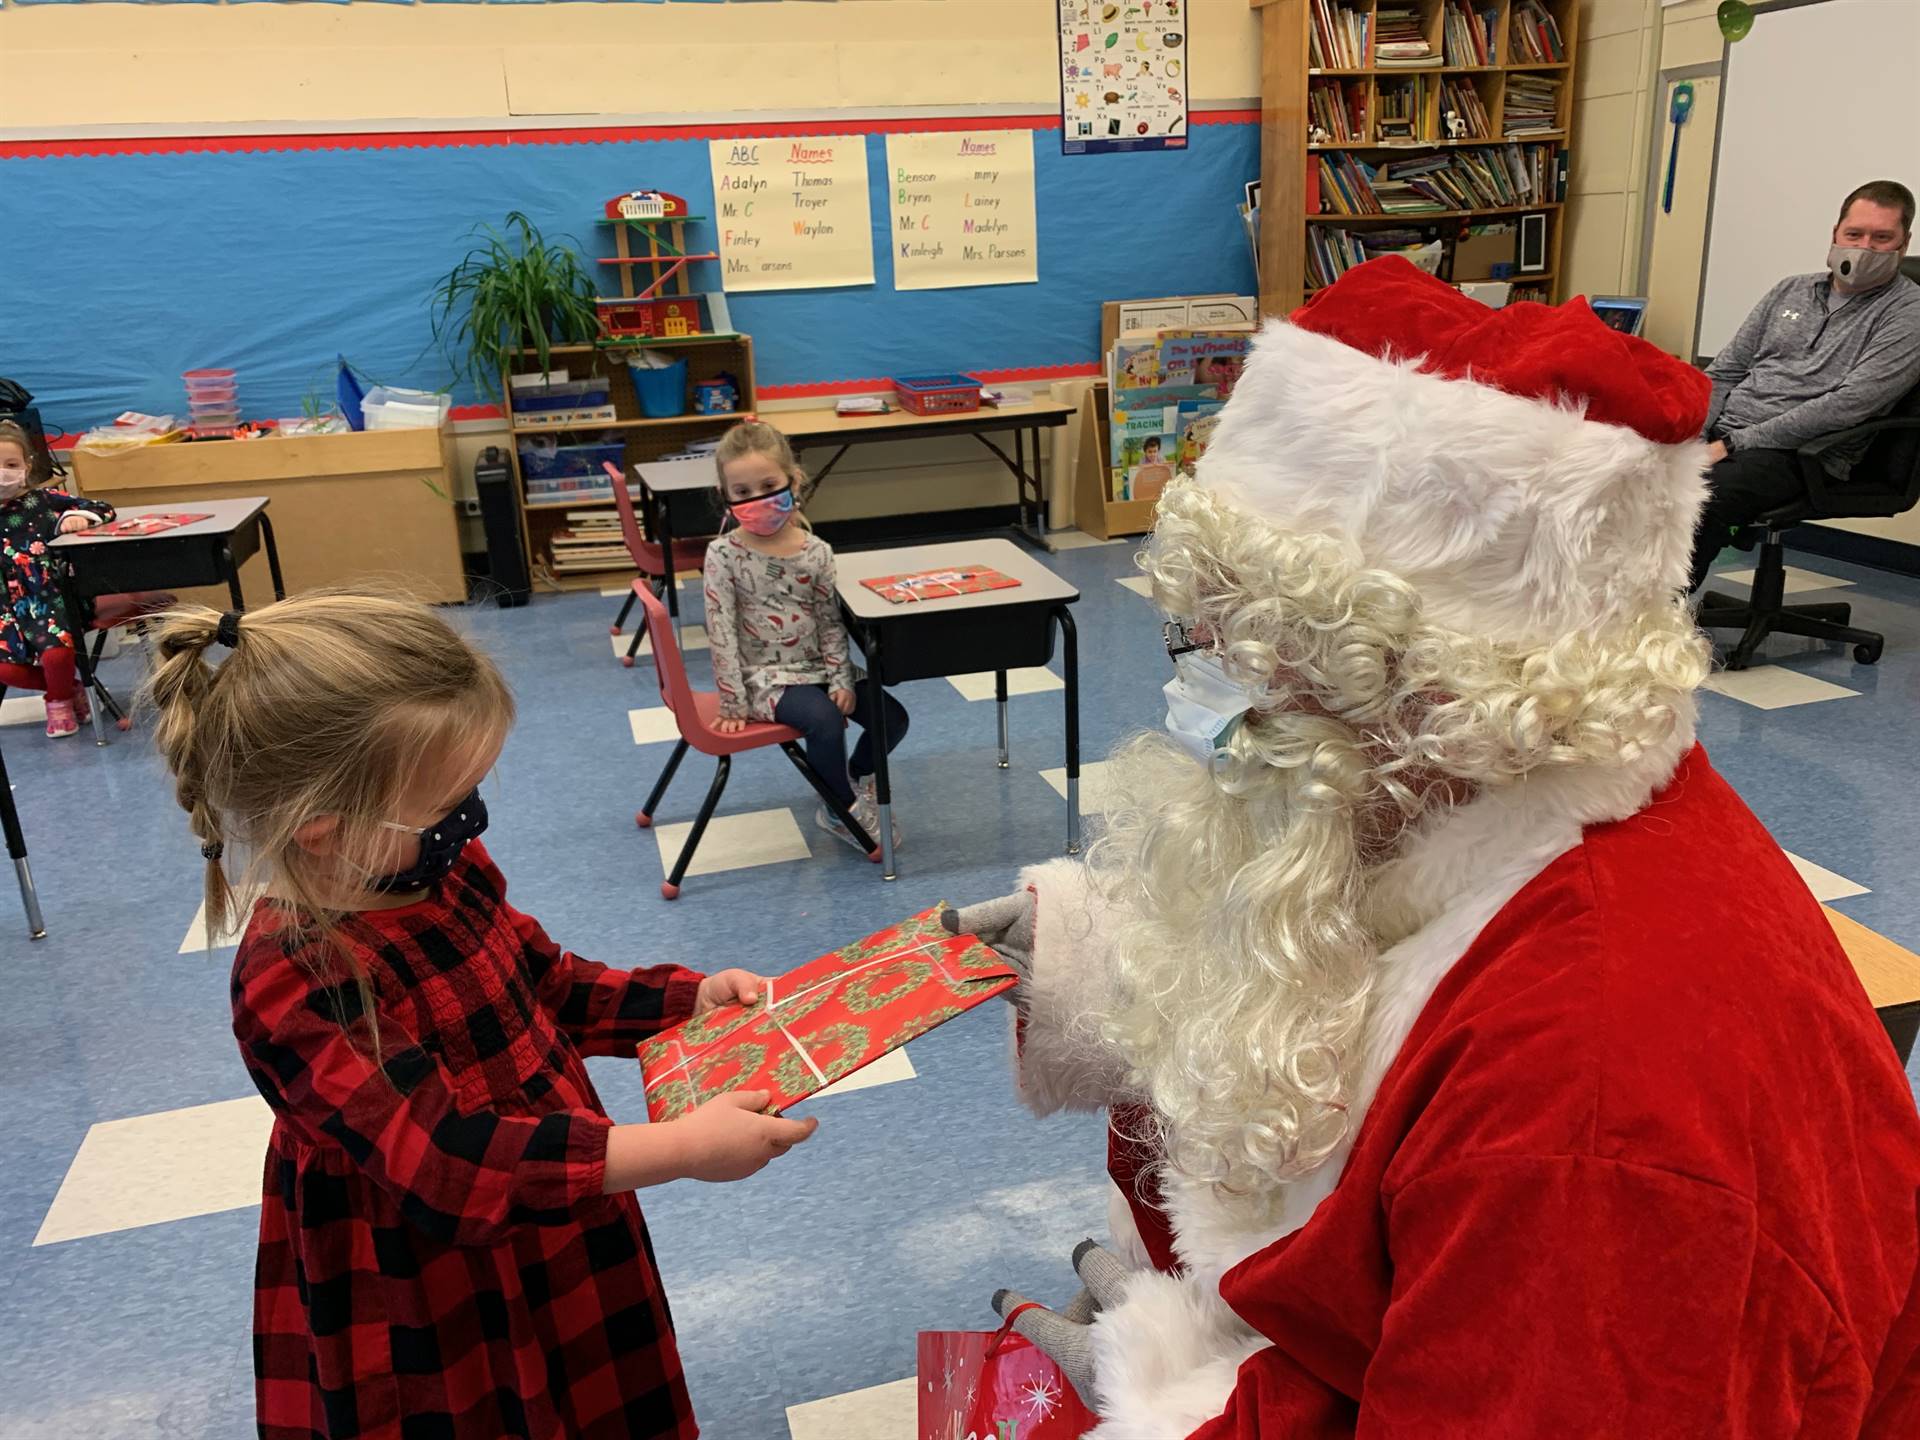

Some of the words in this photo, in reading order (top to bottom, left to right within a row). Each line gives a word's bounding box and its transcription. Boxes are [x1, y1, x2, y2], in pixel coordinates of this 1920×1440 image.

[731, 145, 760, 162] ABC
[790, 143, 833, 160] Names
[961, 137, 996, 153] Names
[792, 171, 833, 187] Thomas
[897, 167, 937, 183] Benson
[720, 174, 767, 194] Adalyn
[791, 192, 829, 210] Troyer
[898, 187, 932, 207] Brynn
[744, 201, 754, 217] C
[793, 219, 834, 239] Waylon
[921, 214, 930, 230] C
[725, 229, 761, 248] Finley
[988, 243, 1027, 258] Parsons
